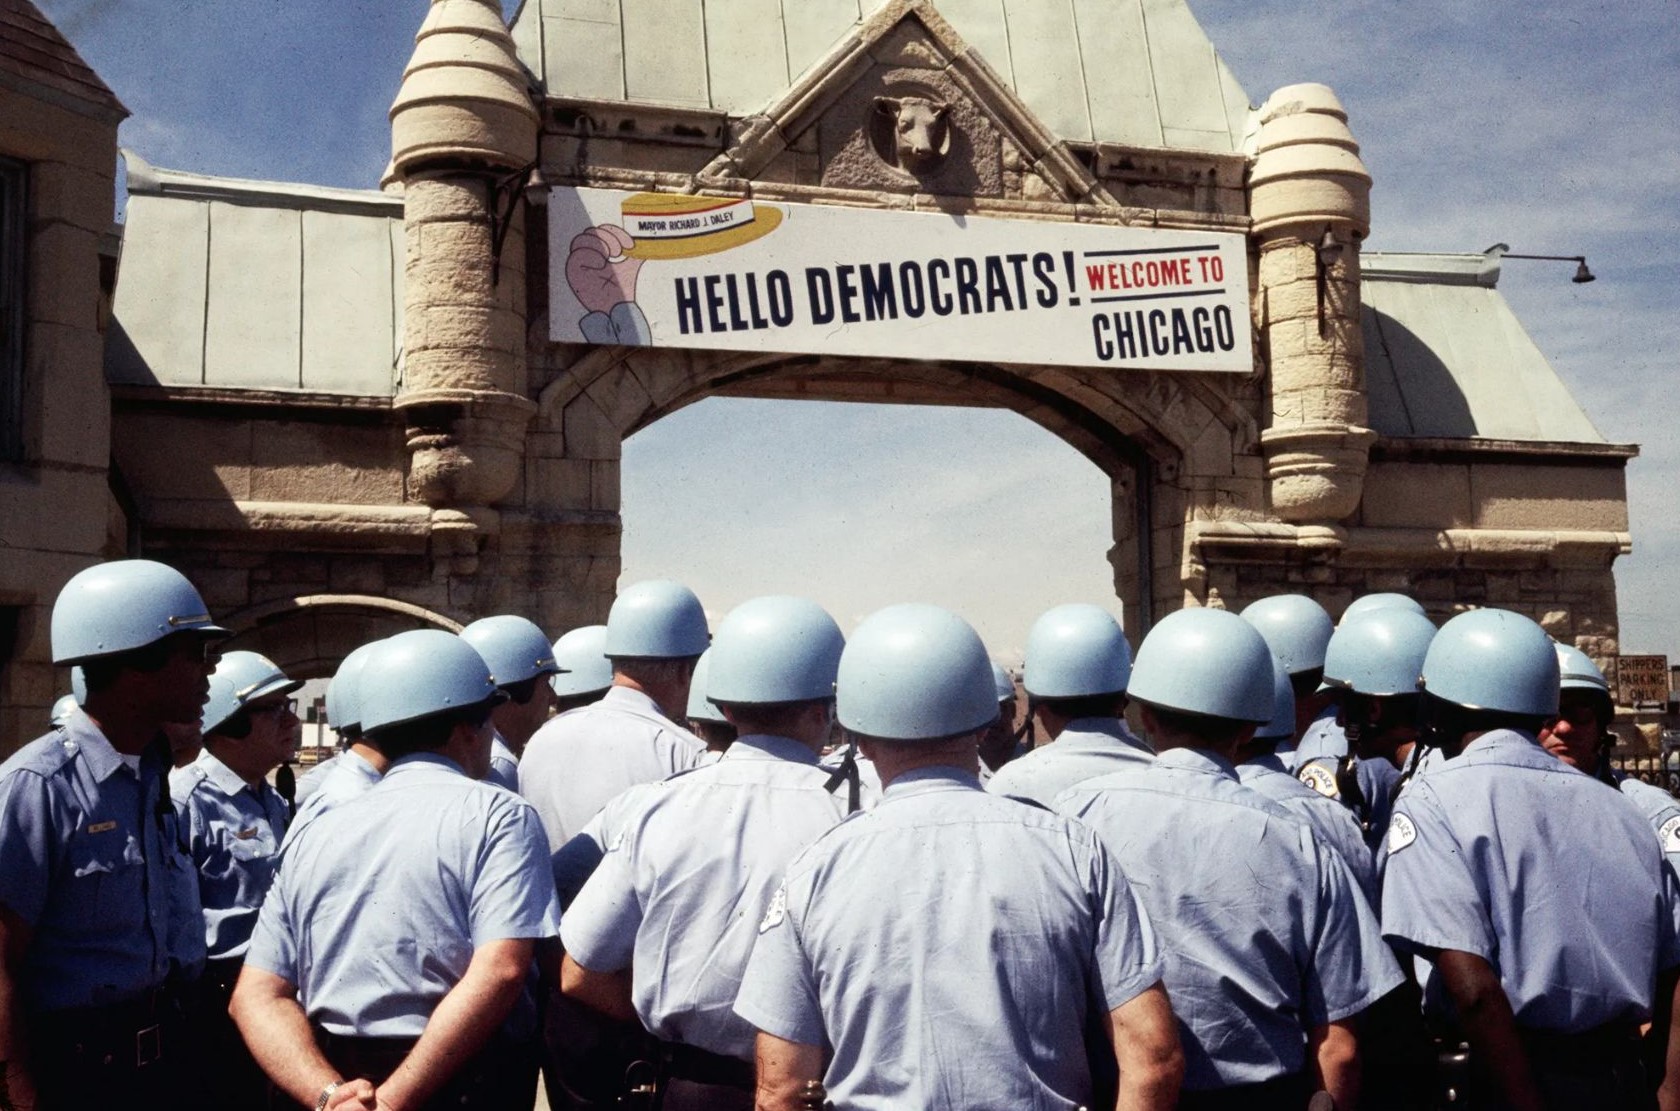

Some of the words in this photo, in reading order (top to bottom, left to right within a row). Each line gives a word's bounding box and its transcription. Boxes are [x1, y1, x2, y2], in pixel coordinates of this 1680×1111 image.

[638, 220, 667, 231] MAYOR
[669, 218, 701, 231] RICHARD
[710, 211, 734, 225] DALEY
[1086, 258, 1193, 291] WELCOME
[1197, 255, 1224, 283] TO
[674, 269, 794, 334] HELLO
[805, 251, 1081, 325] DEMOCRATS!
[1092, 304, 1235, 361] CHICAGO
[1619, 659, 1664, 670] SHIPPERS
[1620, 673, 1665, 685] PARKING
[1630, 688, 1660, 700] ONLY
